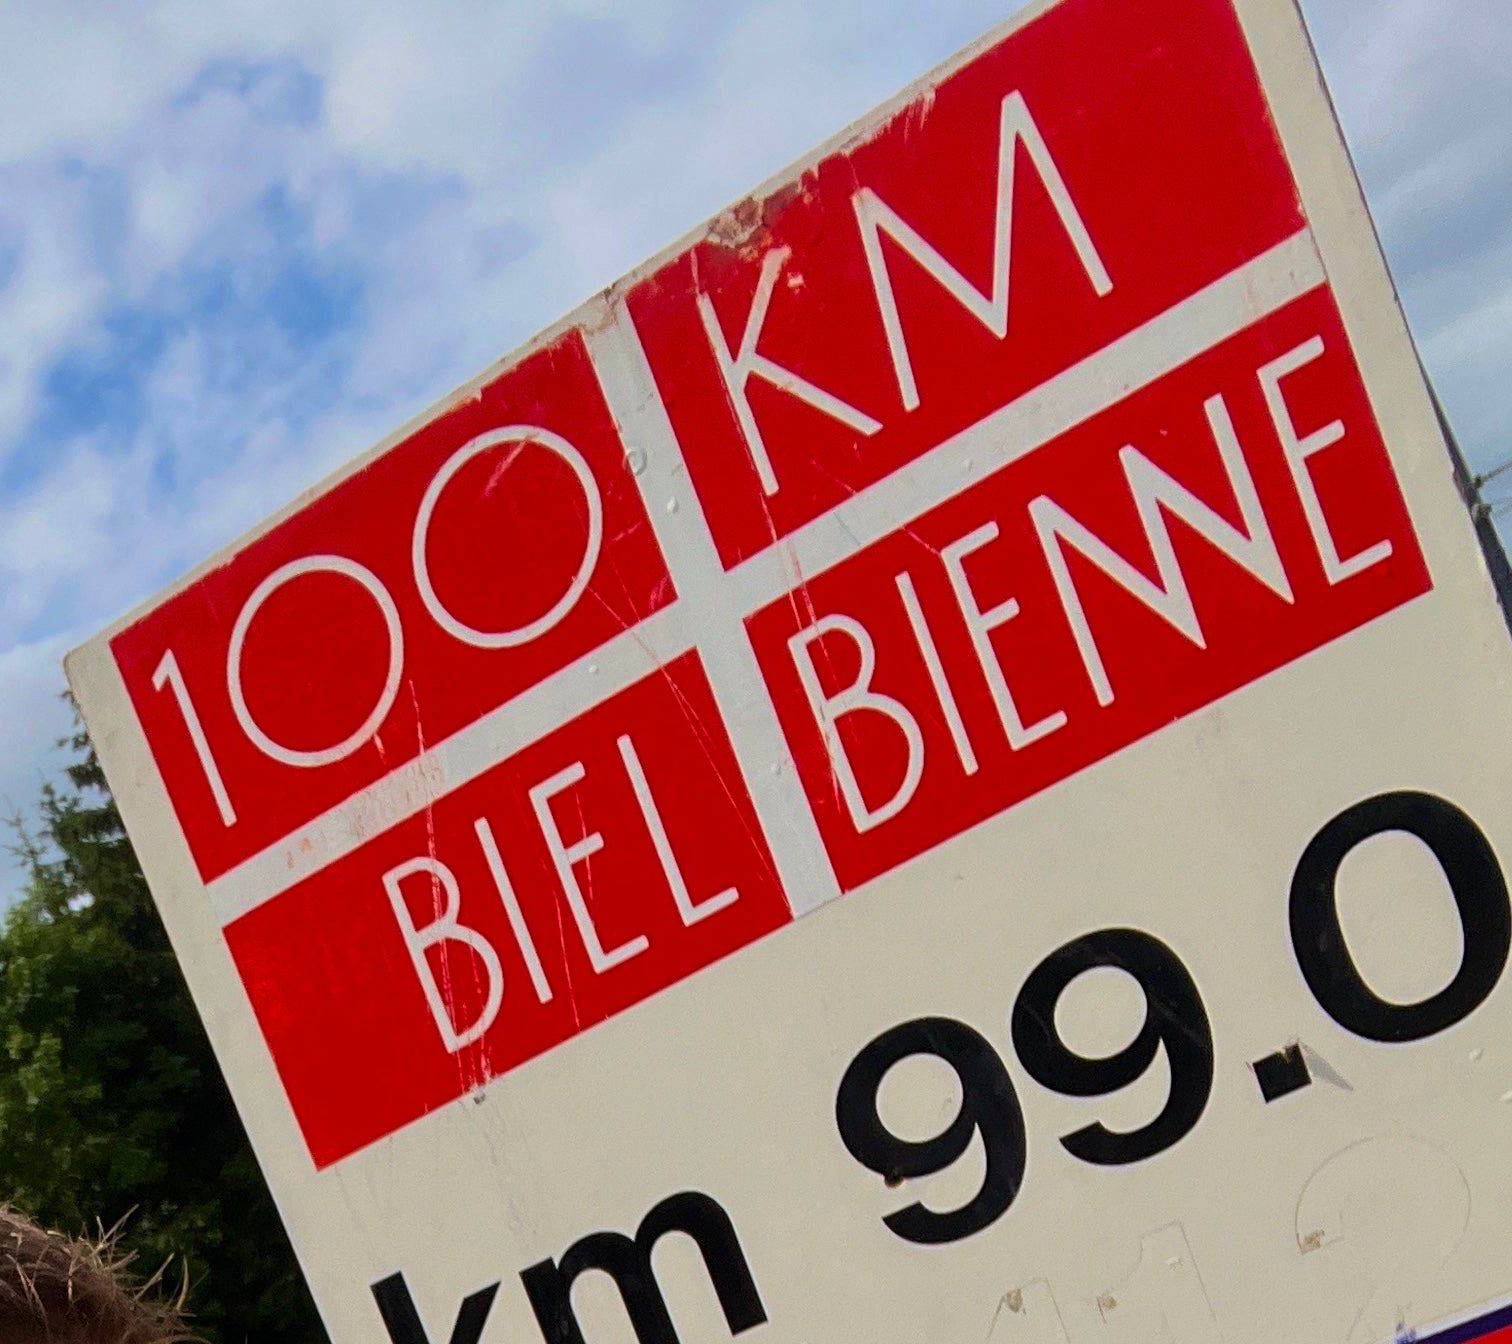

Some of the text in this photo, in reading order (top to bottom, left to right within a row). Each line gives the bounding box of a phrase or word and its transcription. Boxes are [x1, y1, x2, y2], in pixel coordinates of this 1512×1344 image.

[151, 89, 1114, 827] 100 KM
[382, 335, 1393, 1054] BIEL BIENNE
[835, 790, 1512, 1246] 99.0
